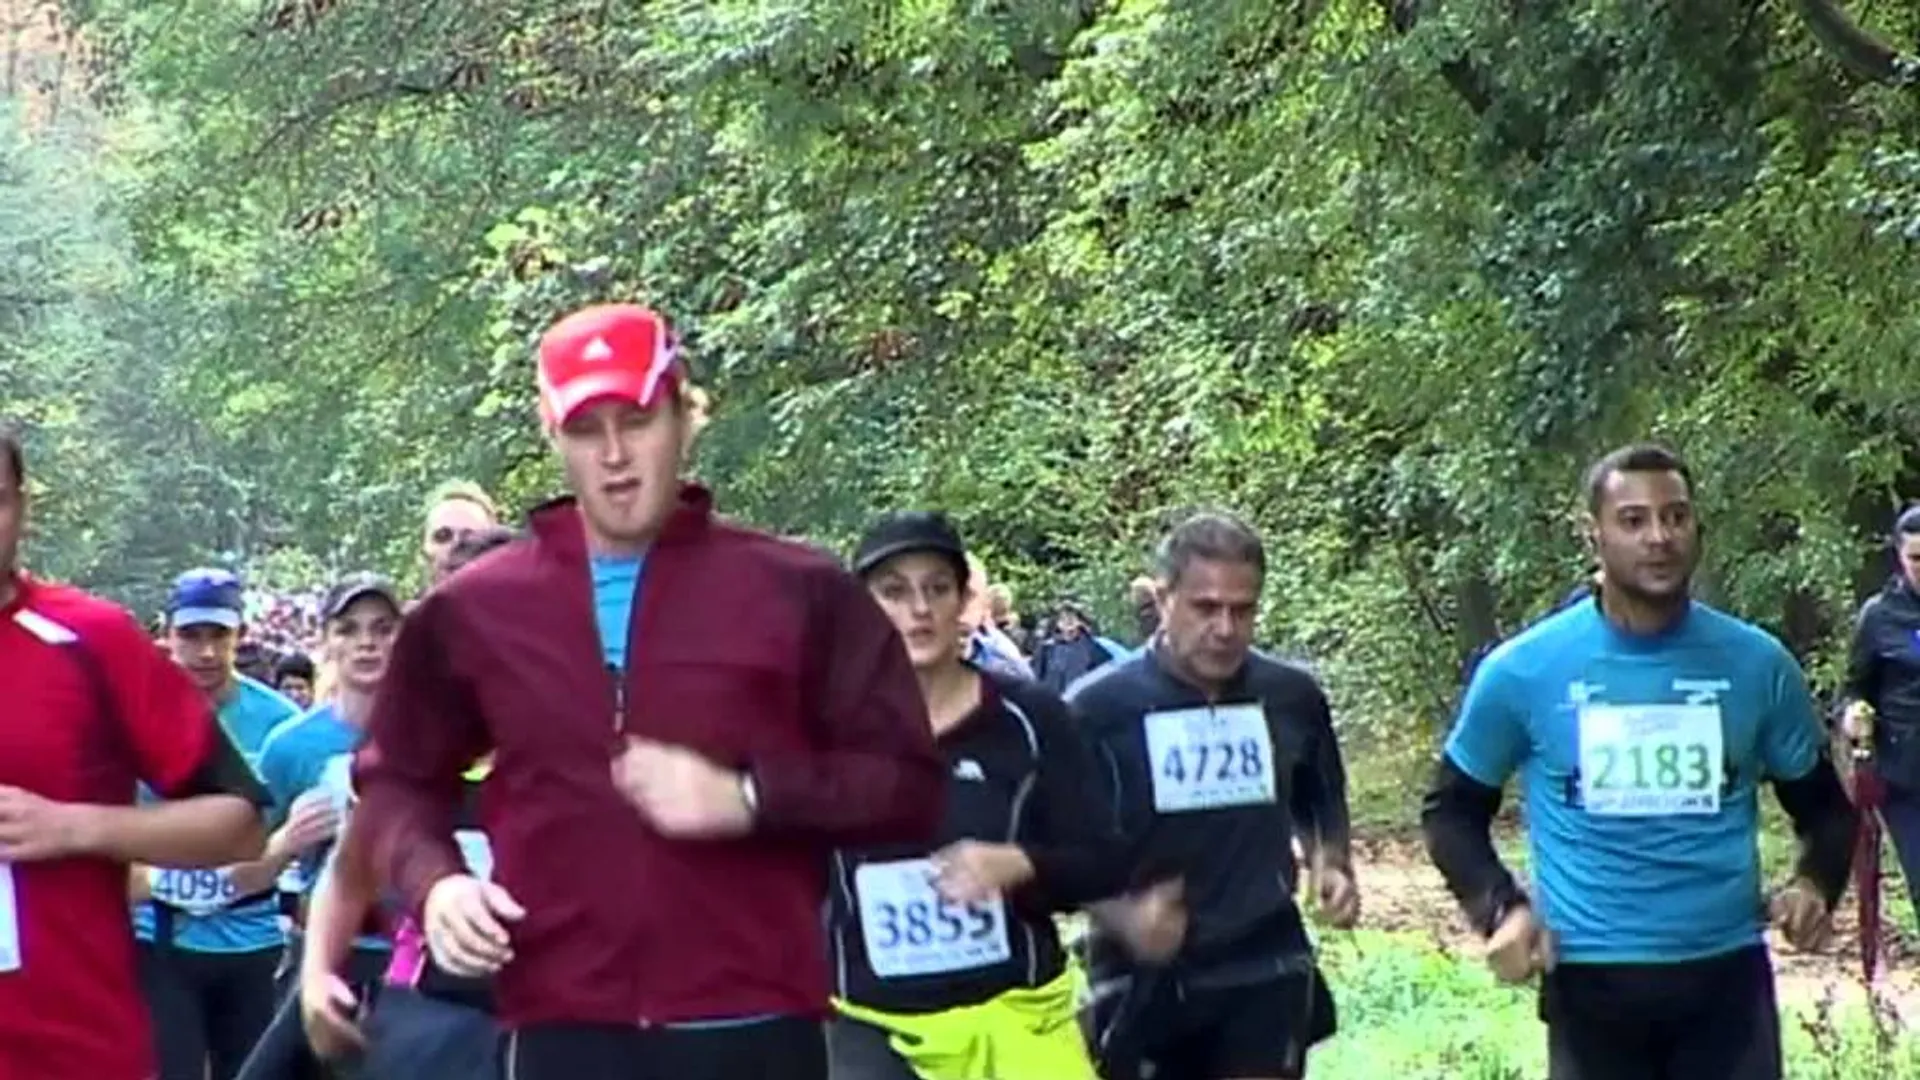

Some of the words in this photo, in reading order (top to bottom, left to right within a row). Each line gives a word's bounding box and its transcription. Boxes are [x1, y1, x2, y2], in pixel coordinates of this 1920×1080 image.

[1162, 738, 1263, 784] 4728
[1591, 742, 1712, 790] 2183
[876, 895, 995, 949] 3855
